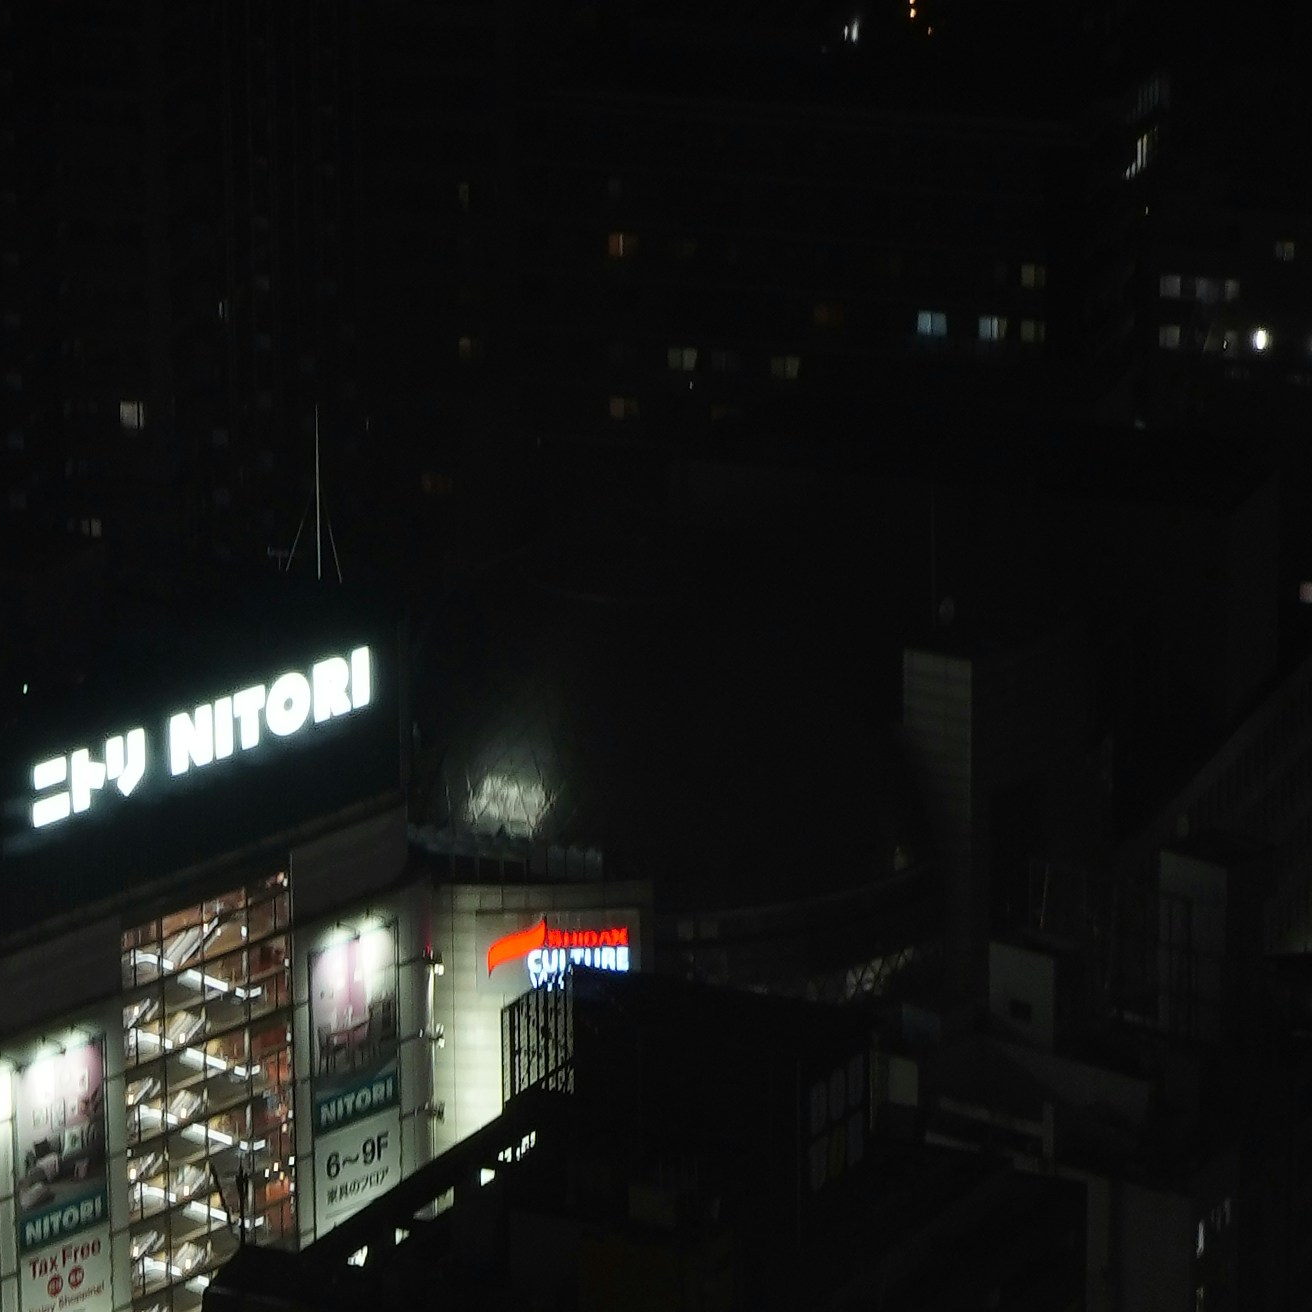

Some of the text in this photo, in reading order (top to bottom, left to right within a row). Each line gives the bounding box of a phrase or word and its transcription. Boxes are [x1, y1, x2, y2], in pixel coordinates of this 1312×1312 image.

[32, 645, 372, 829] ニトリ NITORI
[320, 1077, 393, 1126] NITORI
[25, 1194, 102, 1246] NITORI
[29, 1237, 101, 1281] Tax Free
